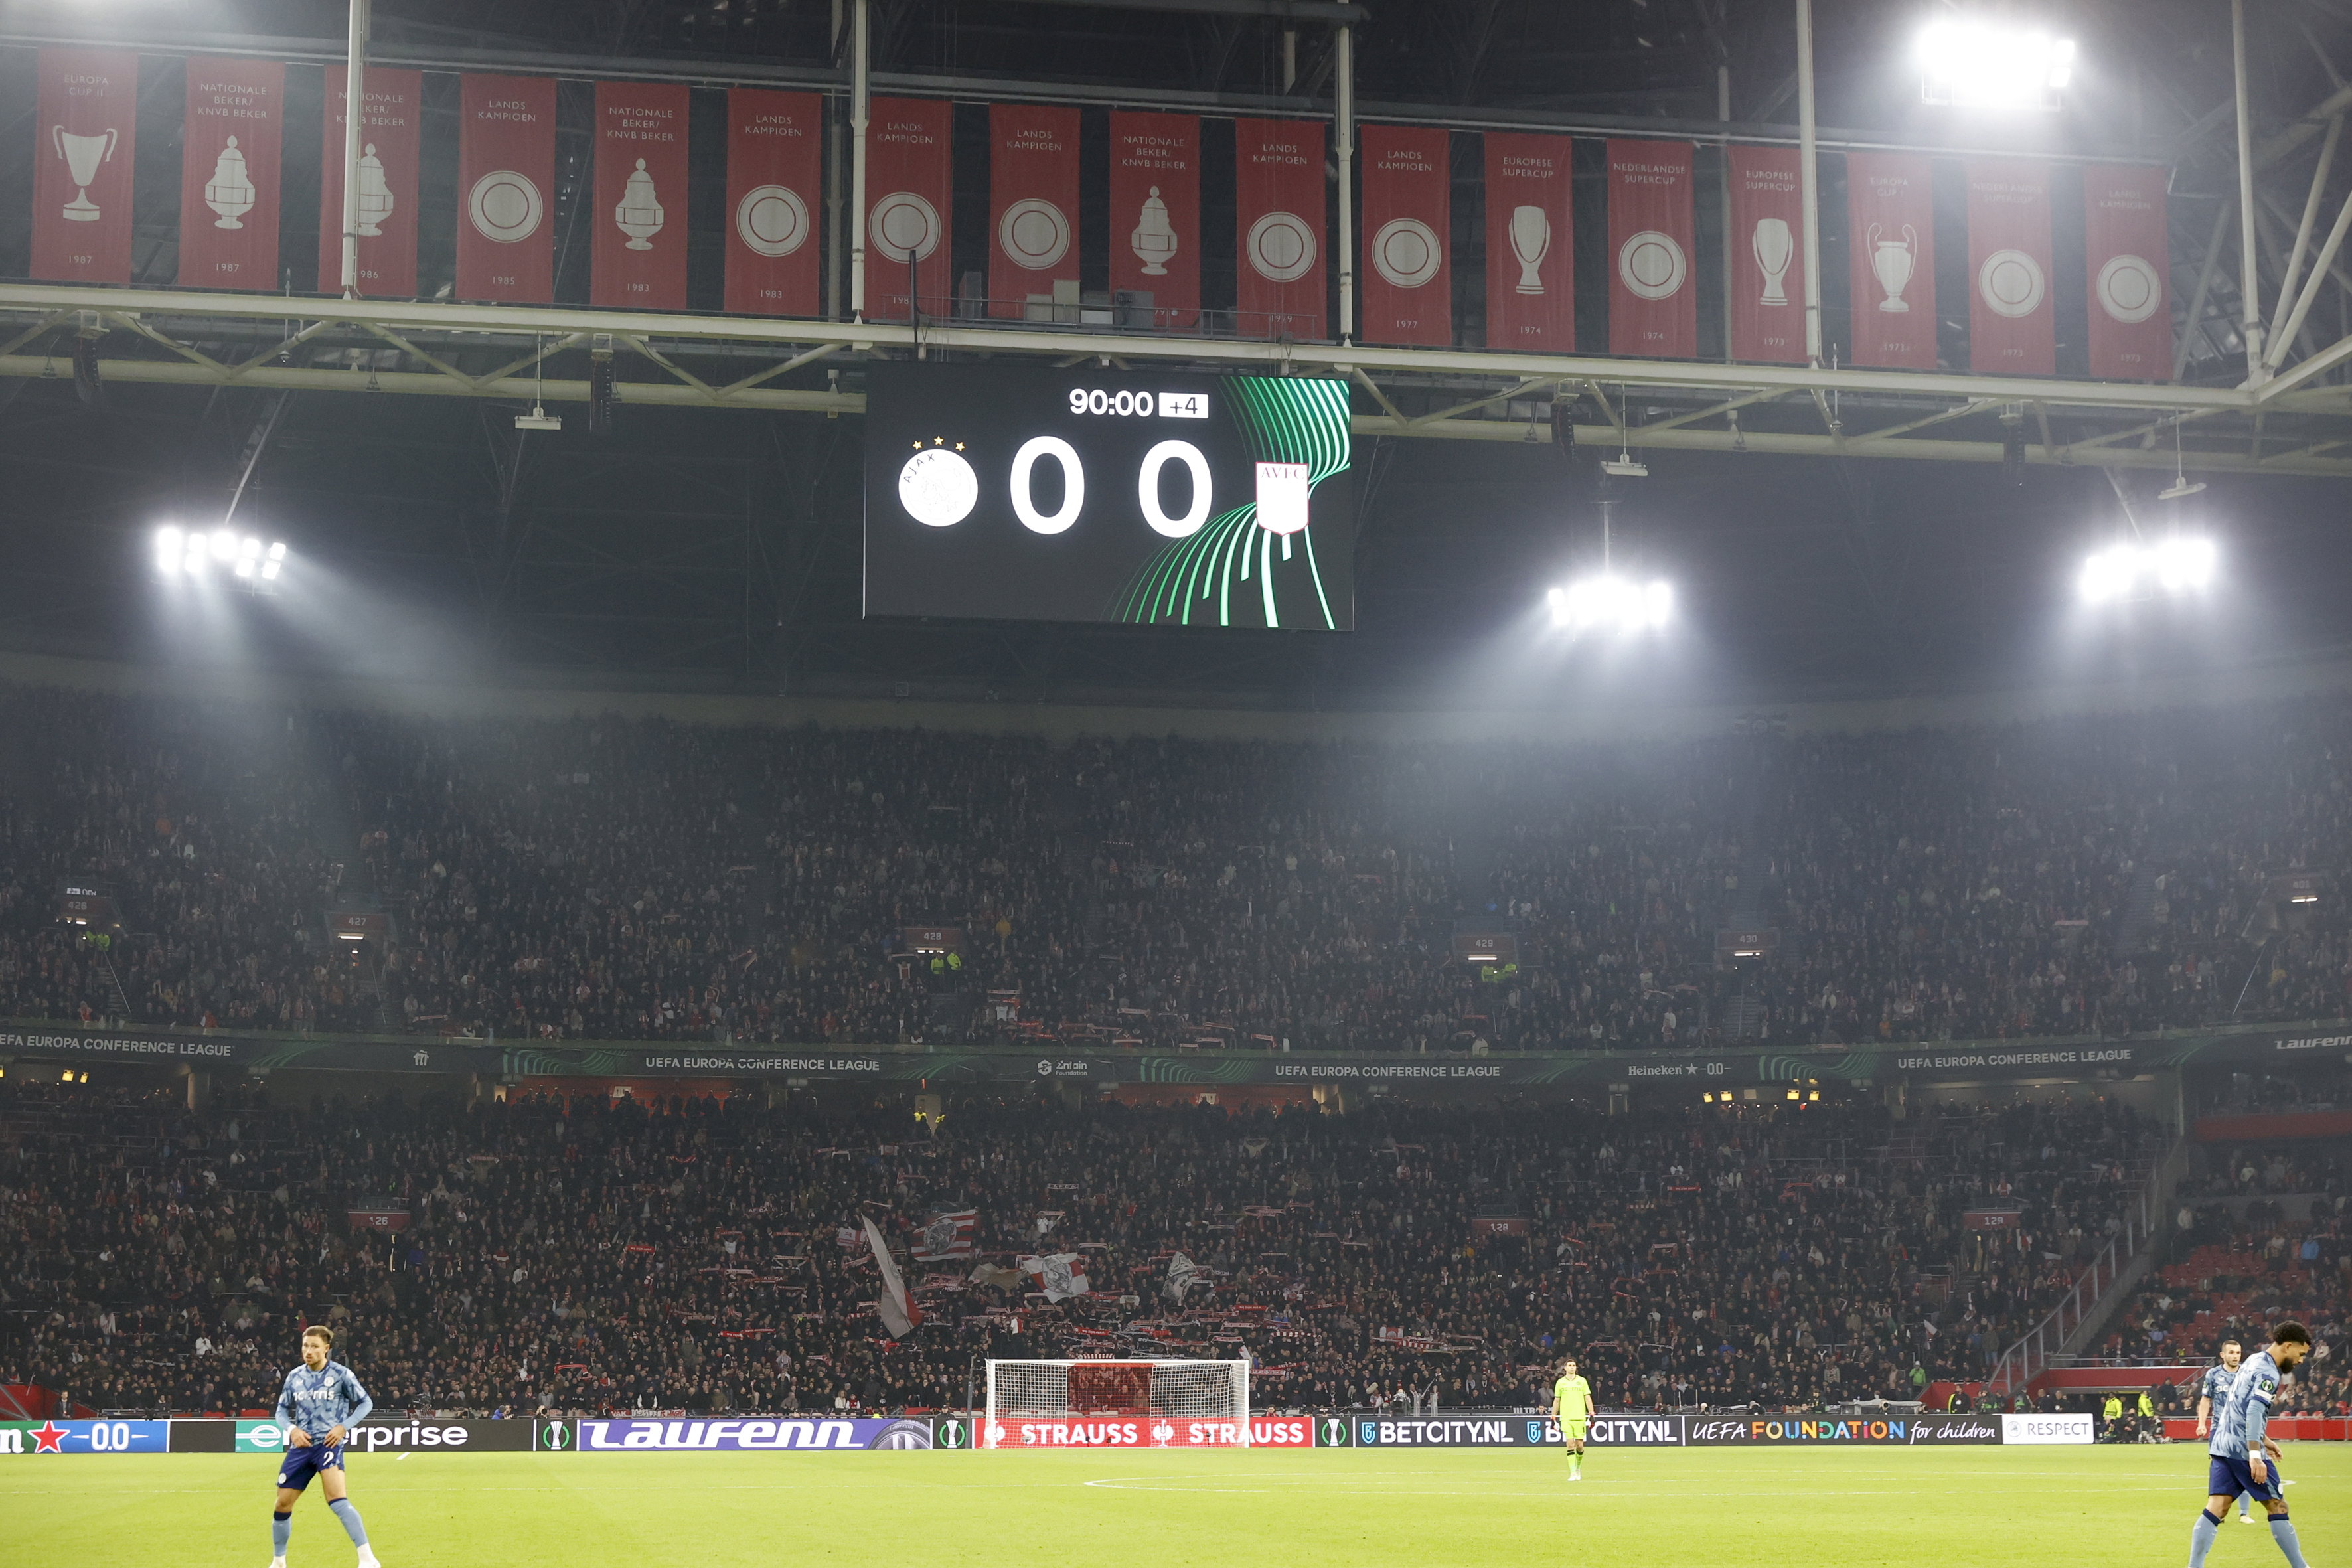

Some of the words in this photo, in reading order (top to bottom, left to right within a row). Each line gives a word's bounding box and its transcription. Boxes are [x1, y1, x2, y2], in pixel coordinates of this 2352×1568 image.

[64, 74, 109, 86] EUROPA
[69, 88, 92, 97] CUP
[200, 84, 266, 95] NATIONALE
[339, 92, 404, 104] NIONALE
[489, 100, 526, 110] LANDS
[198, 107, 228, 118] KNVB
[234, 109, 267, 119] BEKER
[478, 112, 536, 122] KAMPIOEN
[609, 107, 673, 118] NATIONALE
[372, 116, 404, 126] BEKER
[623, 119, 660, 129] BEKER/
[755, 115, 792, 124] LANDS
[745, 125, 802, 137] KAMPIOEN
[887, 122, 923, 132] LANDS
[607, 130, 637, 139] KNVB
[641, 131, 674, 142] BEKER
[876, 133, 933, 144] KAMPIOEN
[1016, 129, 1052, 139] LANDS
[1006, 140, 1062, 151] KAMPIOEN
[1123, 136, 1184, 147] NATIONALE
[1263, 143, 1297, 153] LANDS
[1253, 155, 1308, 165] KAMPIOEN
[1387, 151, 1422, 160] LANDS
[1121, 158, 1150, 167] KNVB
[1154, 160, 1186, 170] BEKER
[1377, 161, 1432, 172] KAMPIOEN
[1503, 157, 1553, 167] EUROPESE
[1502, 168, 1554, 179] SUPERCUP
[1614, 163, 1686, 174] NEDERLANDSE
[1624, 175, 1675, 185] SUPERCUP
[1746, 170, 1794, 181] EUROPESE
[1745, 181, 1796, 192] SUPERCUP
[68, 255, 92, 264] 1987
[216, 263, 240, 272] 1987
[360, 270, 379, 279] 986
[493, 276, 515, 285] 1985
[627, 283, 649, 292] 1983
[760, 289, 783, 299] 1983
[1396, 320, 1417, 329] 1977
[1520, 326, 1541, 335] 1974
[1642, 331, 1664, 340] 1974
[1764, 337, 1785, 346] 1973
[1069, 388, 1154, 416] 90:00
[1170, 398, 1198, 415] +4
[903, 453, 935, 483] AJAX
[1261, 466, 1306, 481] AVFC
[1010, 435, 1085, 535] 0
[1138, 439, 1212, 538] 0
[348, 917, 366, 926] 427
[923, 932, 941, 941] 428
[1739, 935, 1757, 943] 430
[0, 1033, 23, 1046] EFA
[27, 1036, 80, 1050] EUROPA
[84, 1038, 175, 1054] CONFERENCE
[180, 1042, 231, 1057] LEAGUE
[645, 1057, 680, 1068] UEFA
[684, 1058, 734, 1069] EUROPA
[738, 1059, 825, 1071] CONFERENCE
[830, 1059, 880, 1071] LEAGUE
[1897, 1057, 1932, 1069] UEFA
[1935, 1055, 1985, 1068] EUROPA
[1988, 1052, 2077, 1066] CONFERENCE
[2080, 1048, 2132, 1063] LEAGUE
[1275, 1065, 1308, 1077] UEFA
[1312, 1066, 1359, 1077] EUROPA
[1362, 1066, 1447, 1077] CONFERENCE
[1450, 1066, 1500, 1077] LEAGUE
[1628, 1065, 1682, 1077] Heineken
[1490, 1223, 1509, 1232] 128
[1020, 1423, 1138, 1445] STRAUSS
[1189, 1423, 1304, 1444] STRAUSS
[1380, 1421, 1514, 1443] BETCITY.NL
[1692, 1421, 1747, 1440] UEFA
[1751, 1419, 1905, 1439] FOUNDATION
[1909, 1421, 1930, 1445] for
[1937, 1421, 1996, 1439] children
[2027, 1423, 2089, 1435] RESPECT
[583, 1421, 864, 1449] Laufenn
